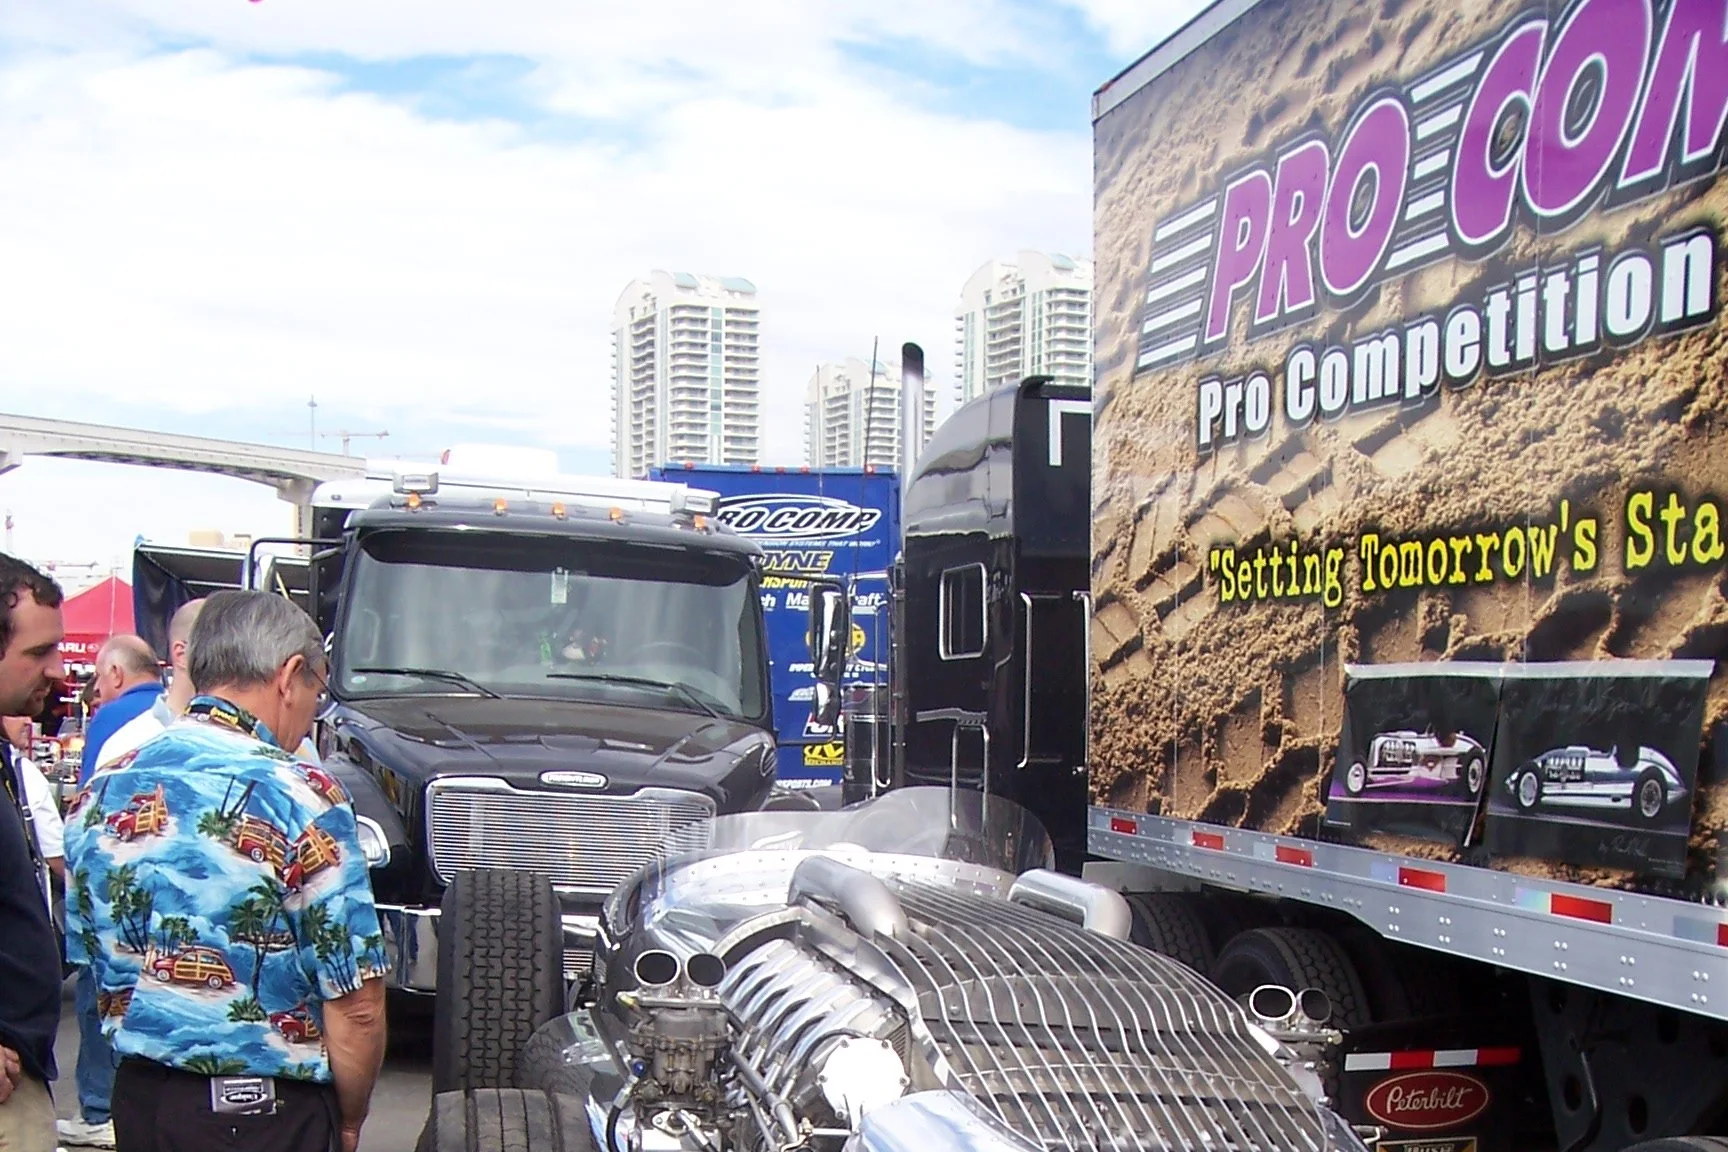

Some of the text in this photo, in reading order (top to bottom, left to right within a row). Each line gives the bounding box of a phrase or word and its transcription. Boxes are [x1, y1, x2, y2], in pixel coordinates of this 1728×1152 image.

[1204, 98, 1411, 344] PRO
[1199, 233, 1714, 445] Pro Competition
[717, 507, 881, 532] RO COMP
[1361, 500, 1597, 592] Tomorrow's
[1626, 491, 1725, 569] Sta
[57, 642, 87, 654] ARU
[1386, 1086, 1473, 1114] Peterbilt
